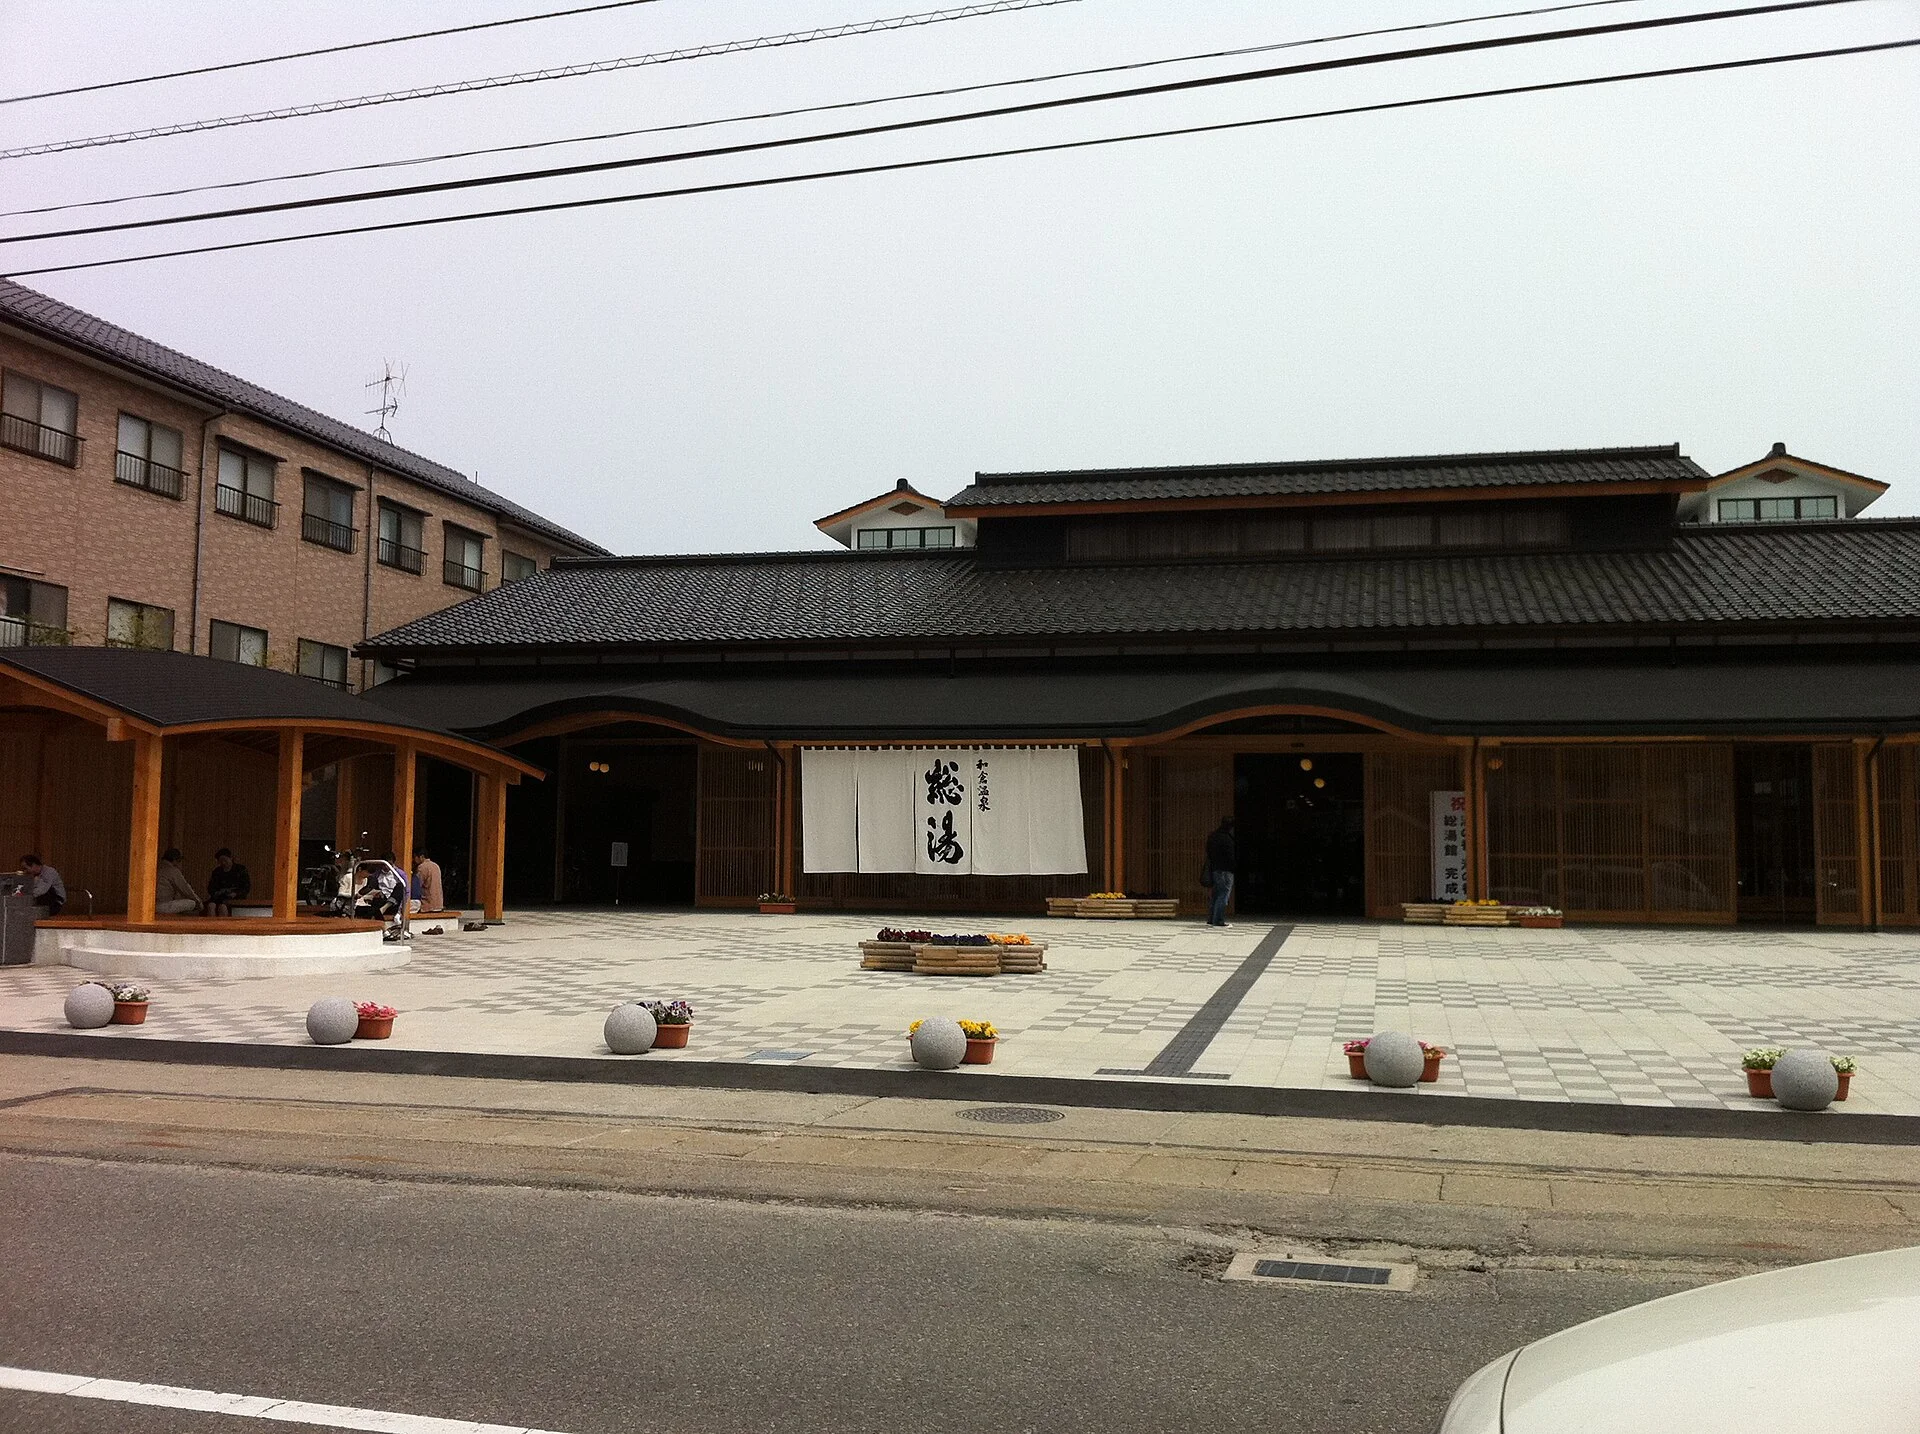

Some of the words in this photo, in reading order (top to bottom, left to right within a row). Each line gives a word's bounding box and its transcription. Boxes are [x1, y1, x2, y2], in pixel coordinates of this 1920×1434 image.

[925, 758, 965, 865] 総湯
[976, 758, 991, 812] 和倉温泉
